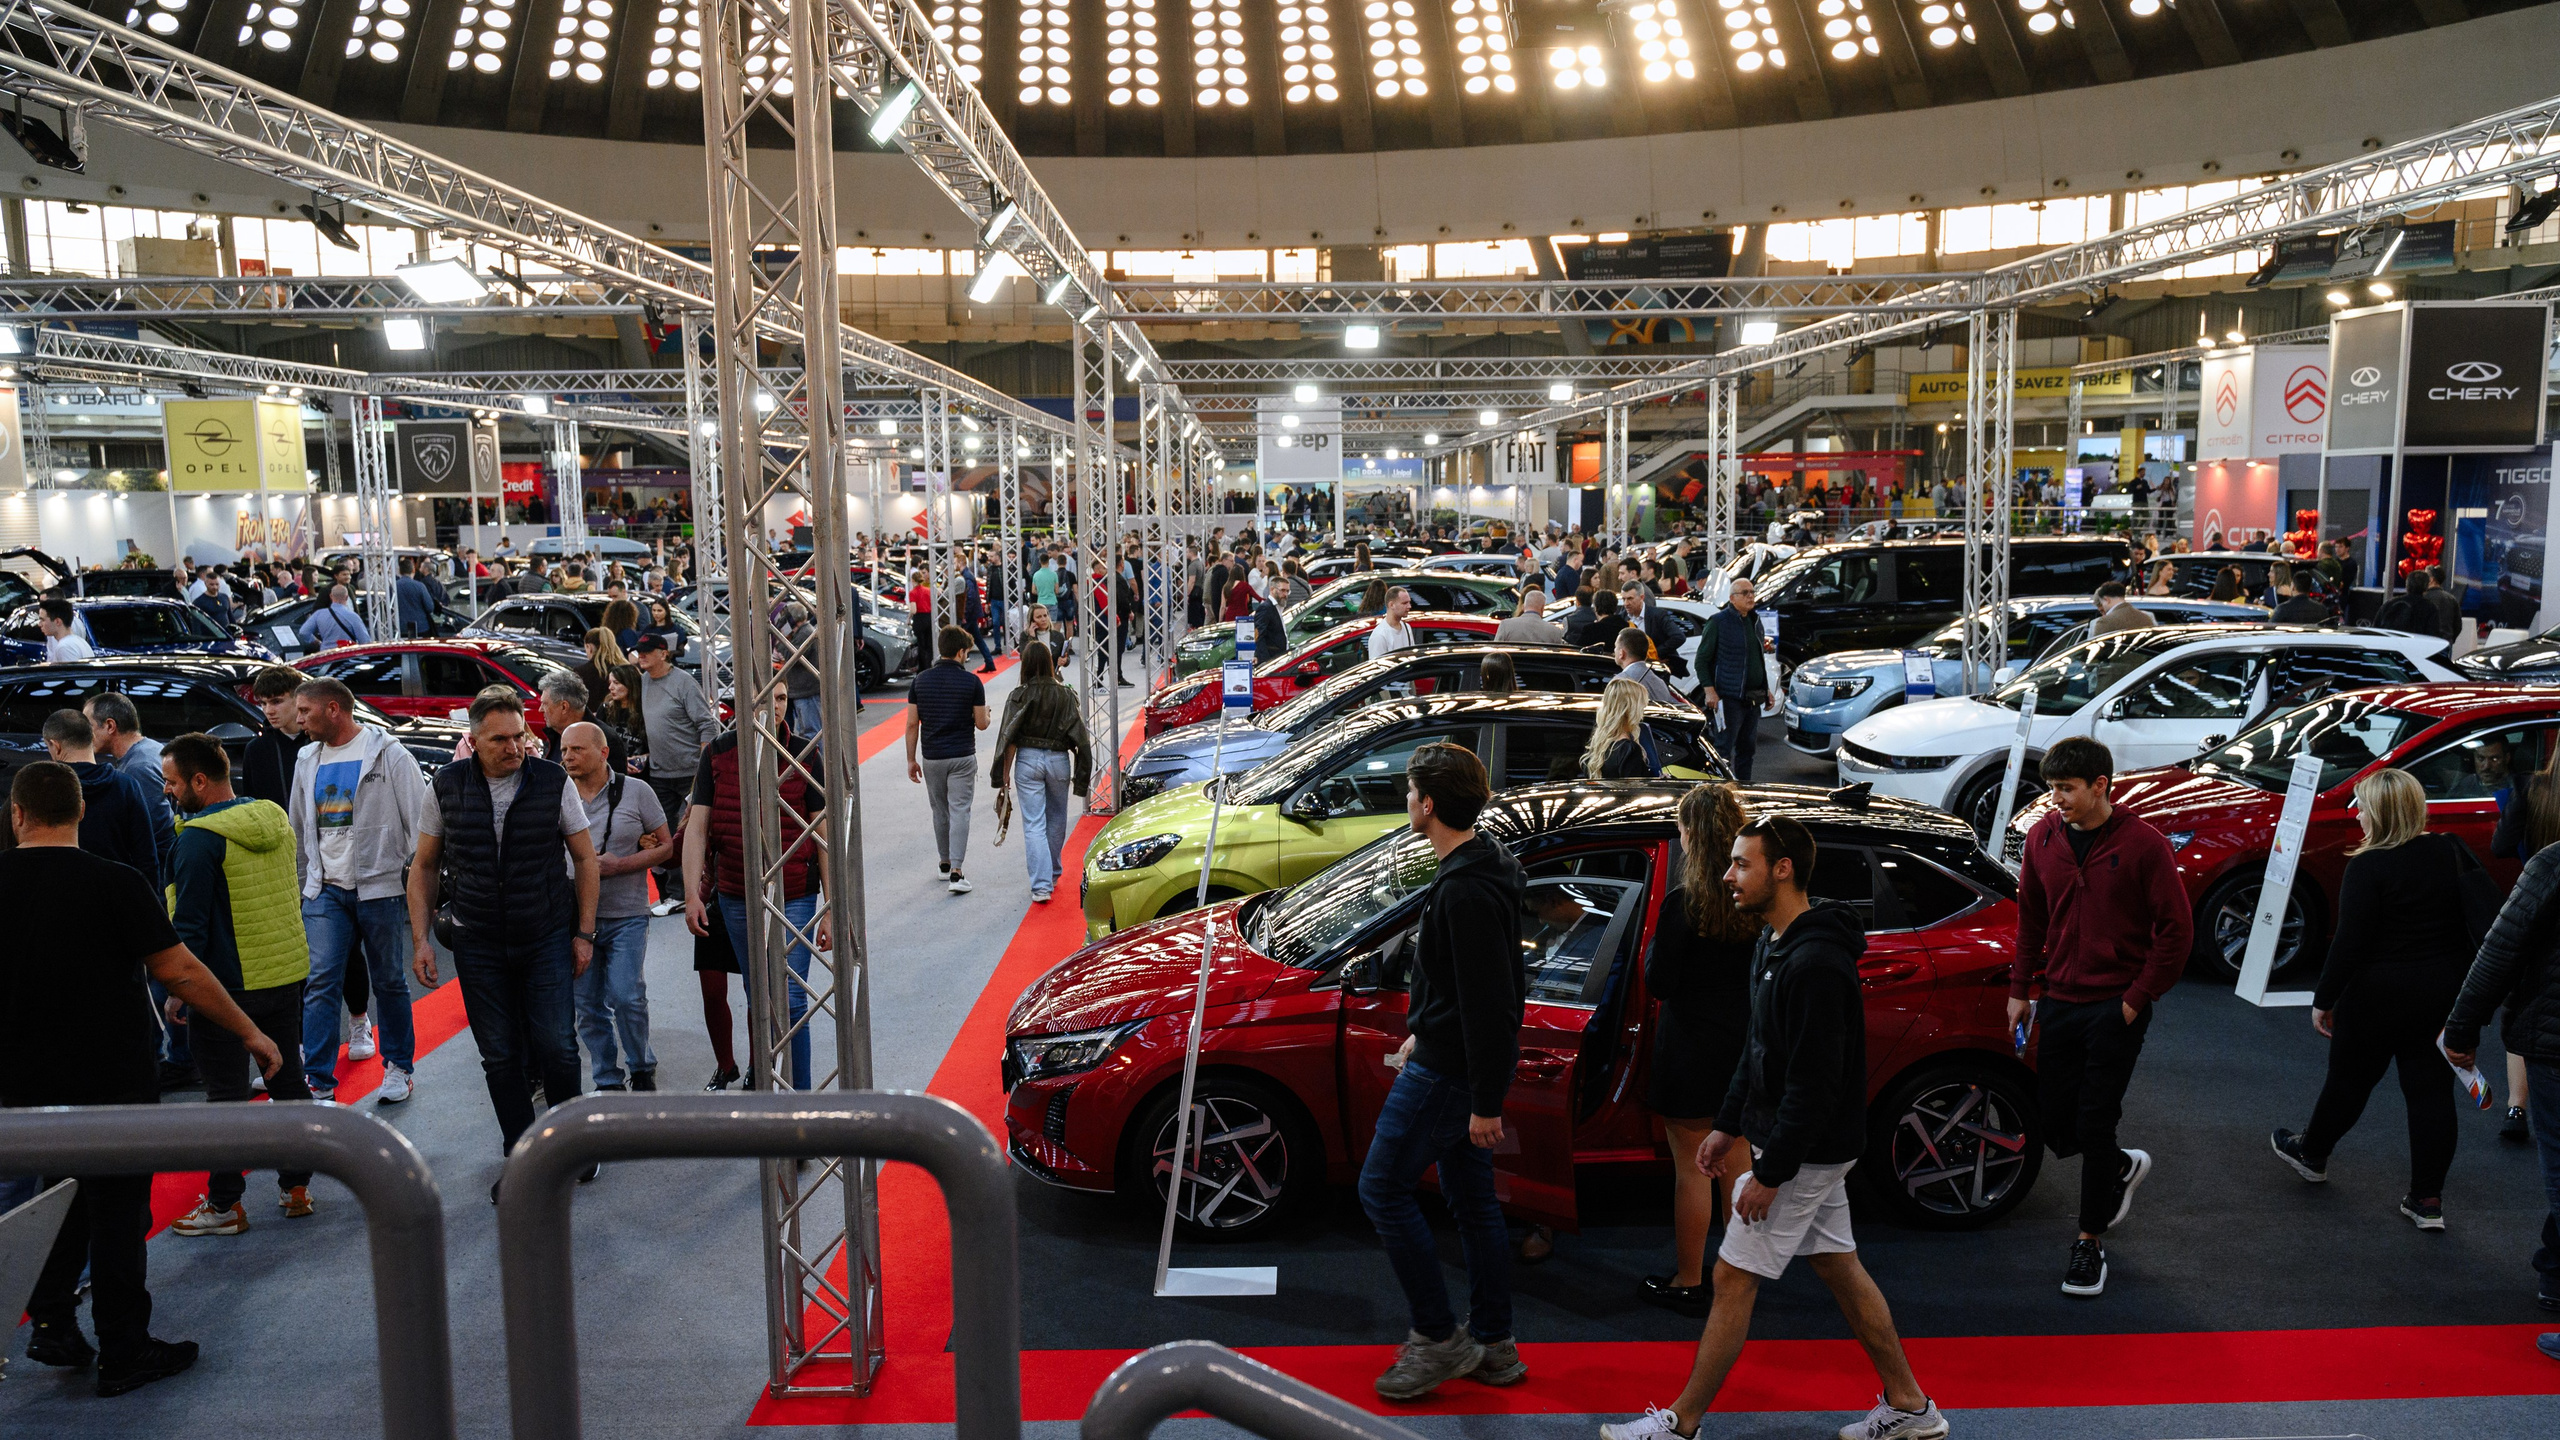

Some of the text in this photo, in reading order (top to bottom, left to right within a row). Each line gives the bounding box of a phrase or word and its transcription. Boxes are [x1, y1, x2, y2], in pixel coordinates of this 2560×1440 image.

[1918, 378, 2010, 394] AUTO-T
[2014, 375, 2064, 389] SAVEZ
[51, 394, 143, 406] SUBARU
[2340, 389, 2390, 406] CHERY
[2427, 387, 2520, 400] CHERY
[1272, 434, 1329, 452] eep
[2266, 433, 2323, 445] CITRO
[1507, 441, 1547, 473] FIAT
[186, 463, 247, 474] OPEL
[269, 463, 298, 474] OPEL
[502, 479, 535, 493] Credit
[2494, 499, 2505, 521] 7
[235, 510, 292, 551] FRONERA
[2227, 526, 2276, 546] CITR
